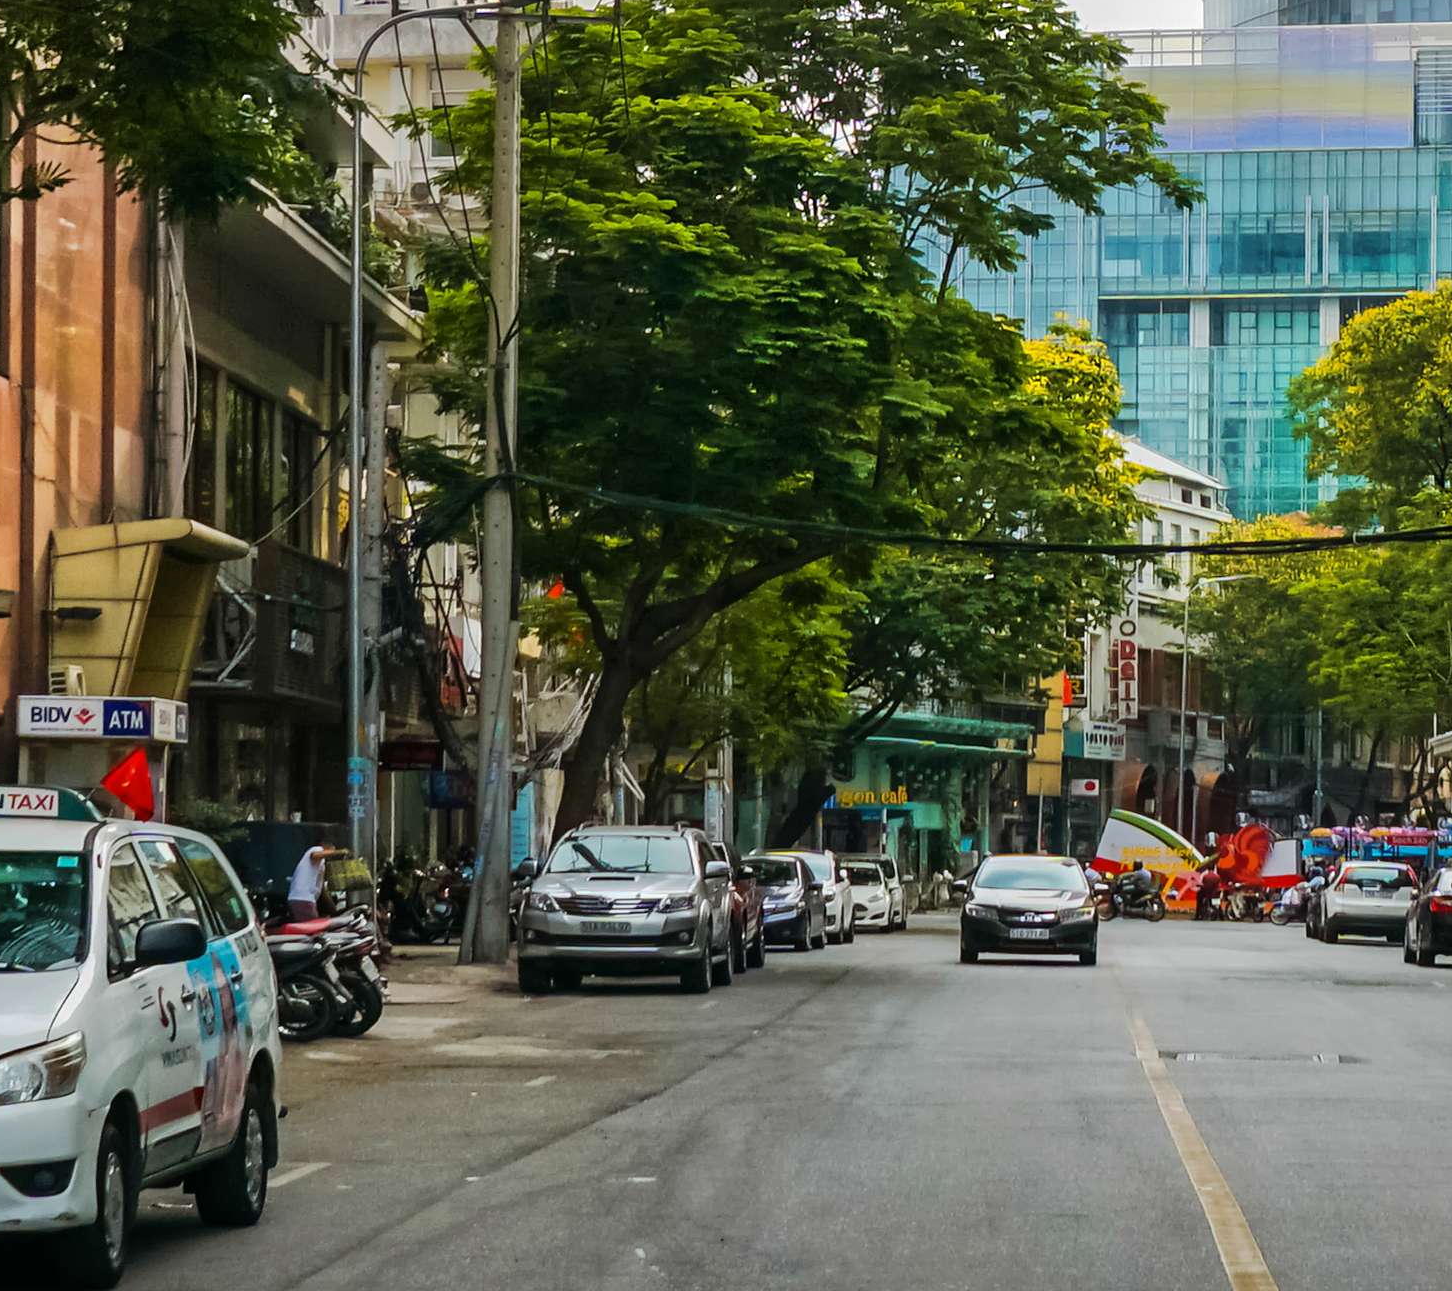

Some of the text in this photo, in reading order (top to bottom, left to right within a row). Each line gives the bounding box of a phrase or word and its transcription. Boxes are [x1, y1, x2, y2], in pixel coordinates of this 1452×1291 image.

[31, 705, 72, 724] BIDV
[108, 709, 144, 731] ATM
[7, 794, 56, 812] TAXI
